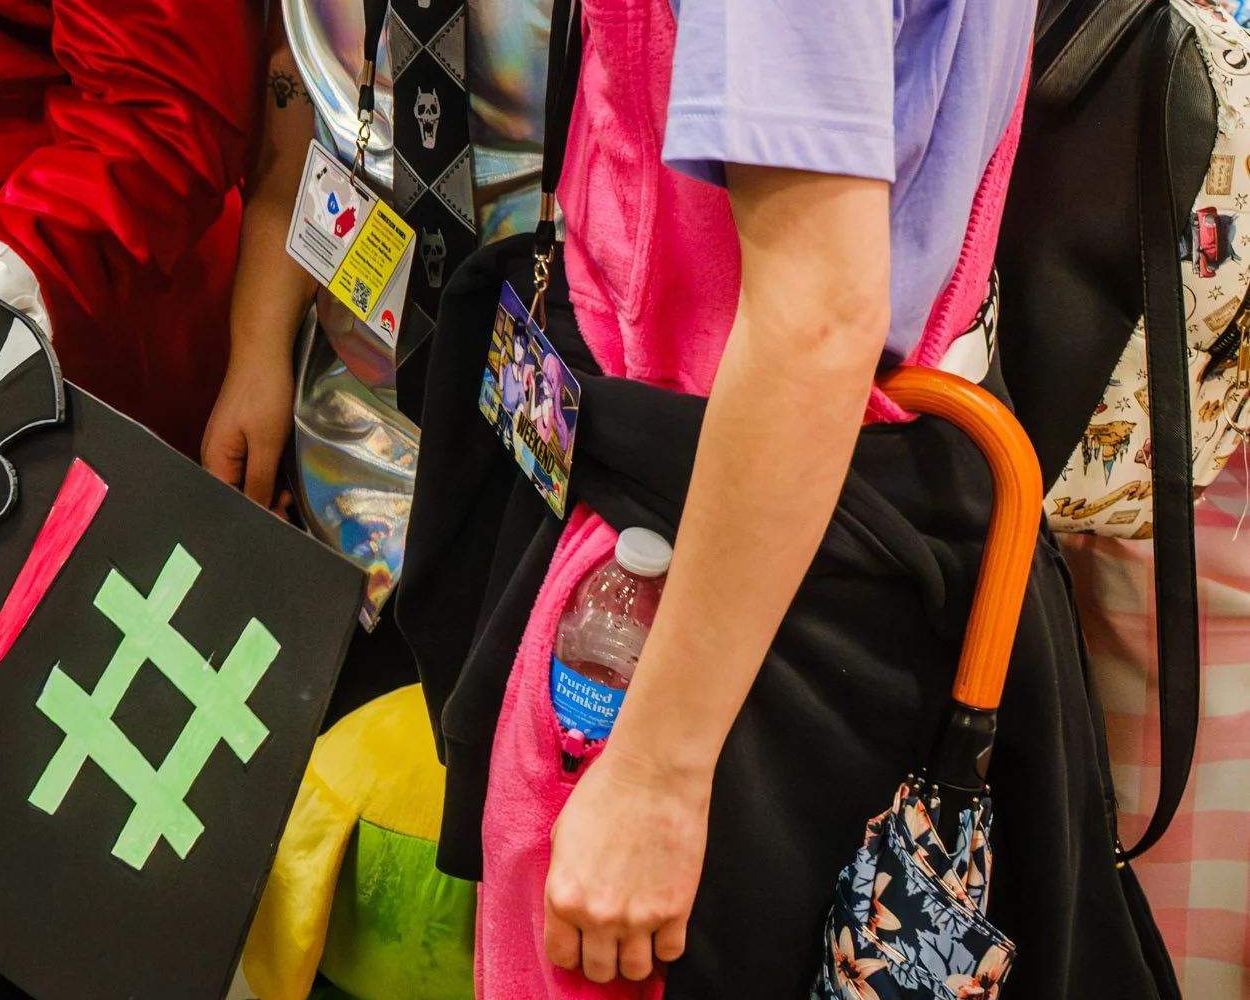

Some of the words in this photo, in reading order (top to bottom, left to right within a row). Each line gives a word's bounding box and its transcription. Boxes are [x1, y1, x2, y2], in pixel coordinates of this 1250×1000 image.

[516, 411, 555, 475] WEEKEND
[556, 682, 615, 717] Drinking
[559, 671, 613, 704] Purified
